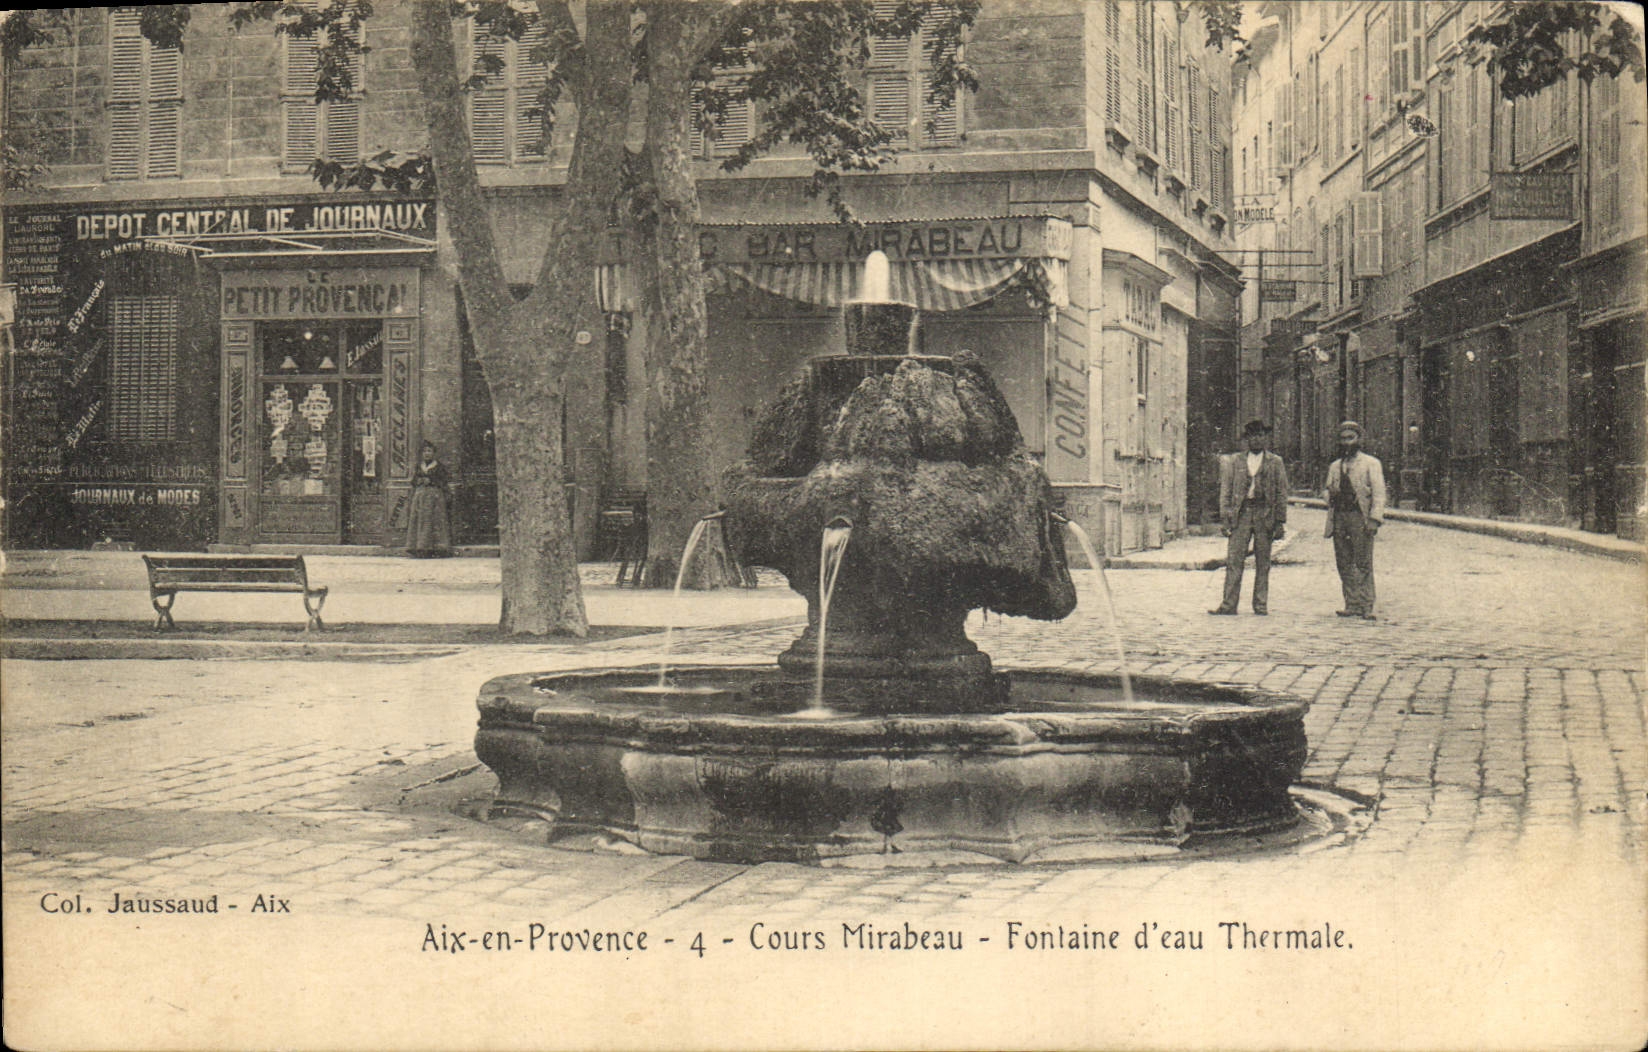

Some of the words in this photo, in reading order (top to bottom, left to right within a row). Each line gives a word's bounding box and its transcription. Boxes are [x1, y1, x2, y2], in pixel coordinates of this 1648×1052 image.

[76, 213, 147, 240] DEPOT
[157, 209, 259, 237] CENTRAL
[266, 207, 295, 233] DE
[305, 203, 428, 231] JOURNAUX
[747, 229, 816, 260] BAR
[845, 222, 1022, 260] MIRABEAU
[223, 286, 283, 314] PETIT
[71, 488, 135, 505] JOURNAUX
[137, 491, 154, 505] de
[157, 488, 200, 505] MODES
